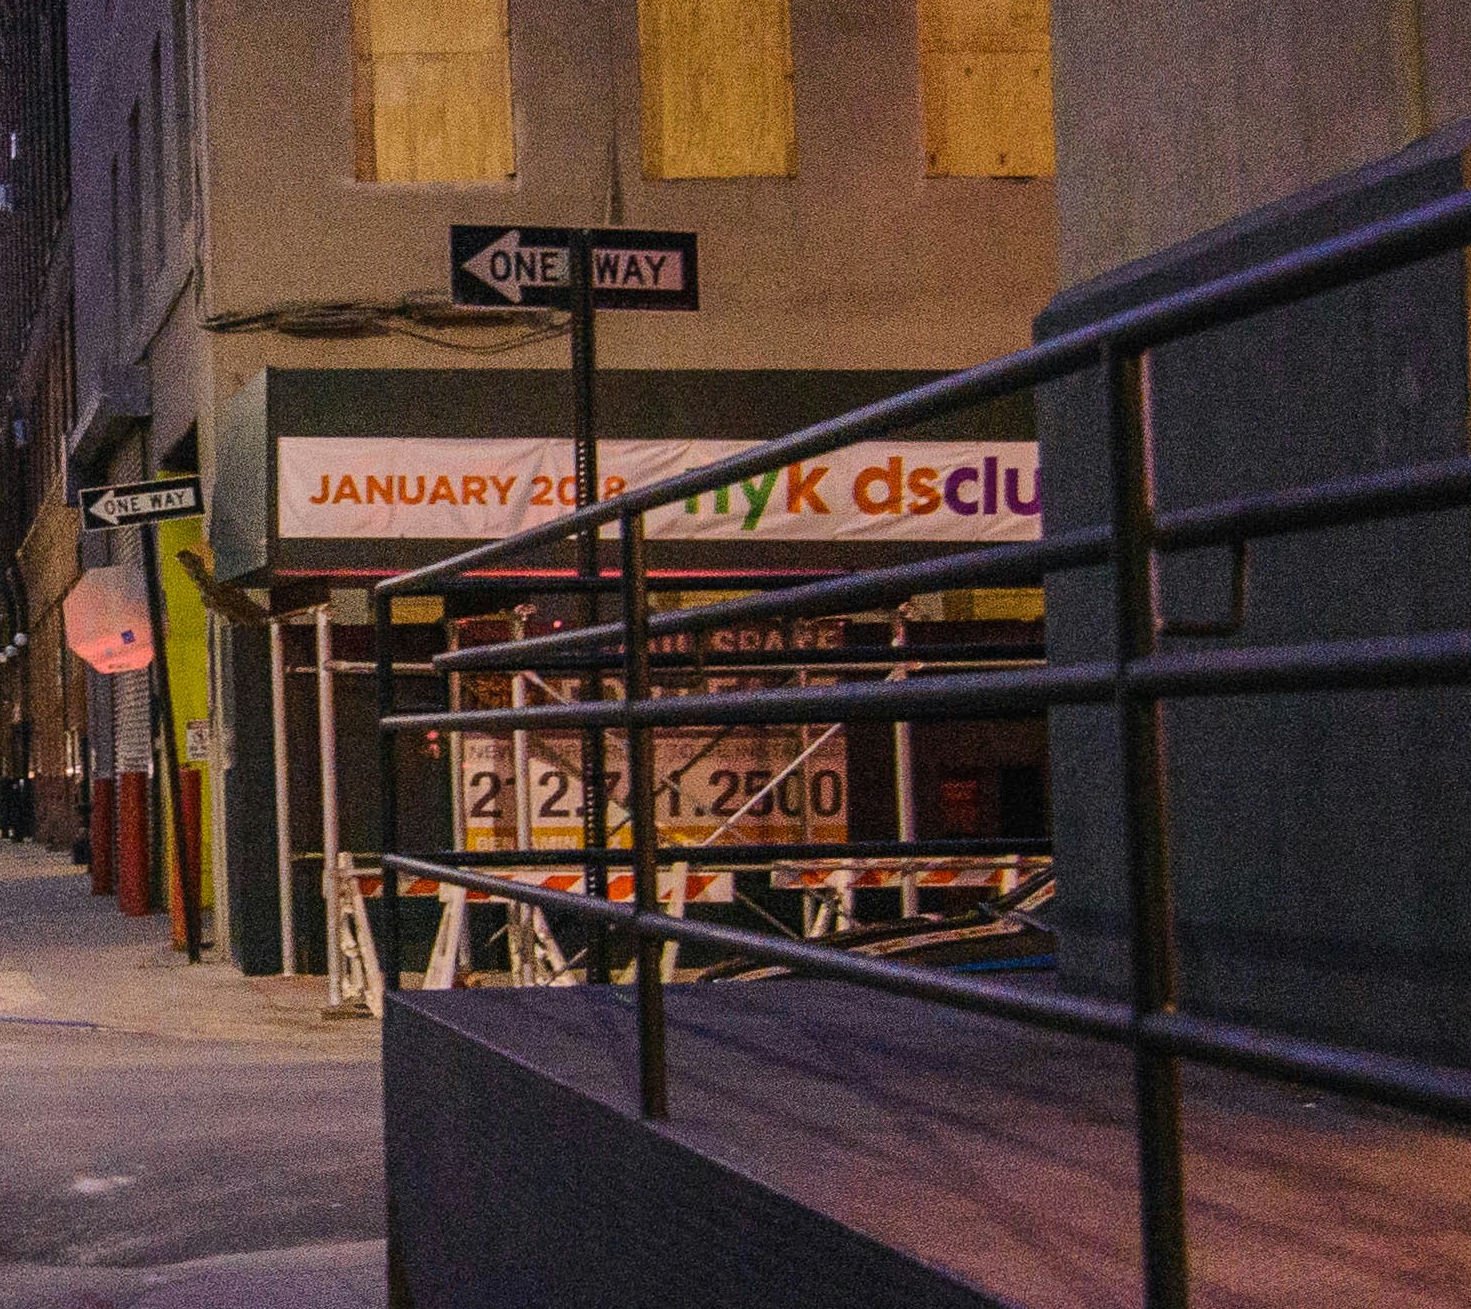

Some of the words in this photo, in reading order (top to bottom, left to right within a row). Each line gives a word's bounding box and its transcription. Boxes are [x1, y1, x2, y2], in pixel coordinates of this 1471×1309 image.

[489, 250, 559, 283] ONE
[594, 253, 667, 286] WAY
[104, 496, 141, 515] ONE
[150, 490, 185, 508] WAY
[310, 474, 517, 505] JANUARY
[529, 474, 626, 506] 208
